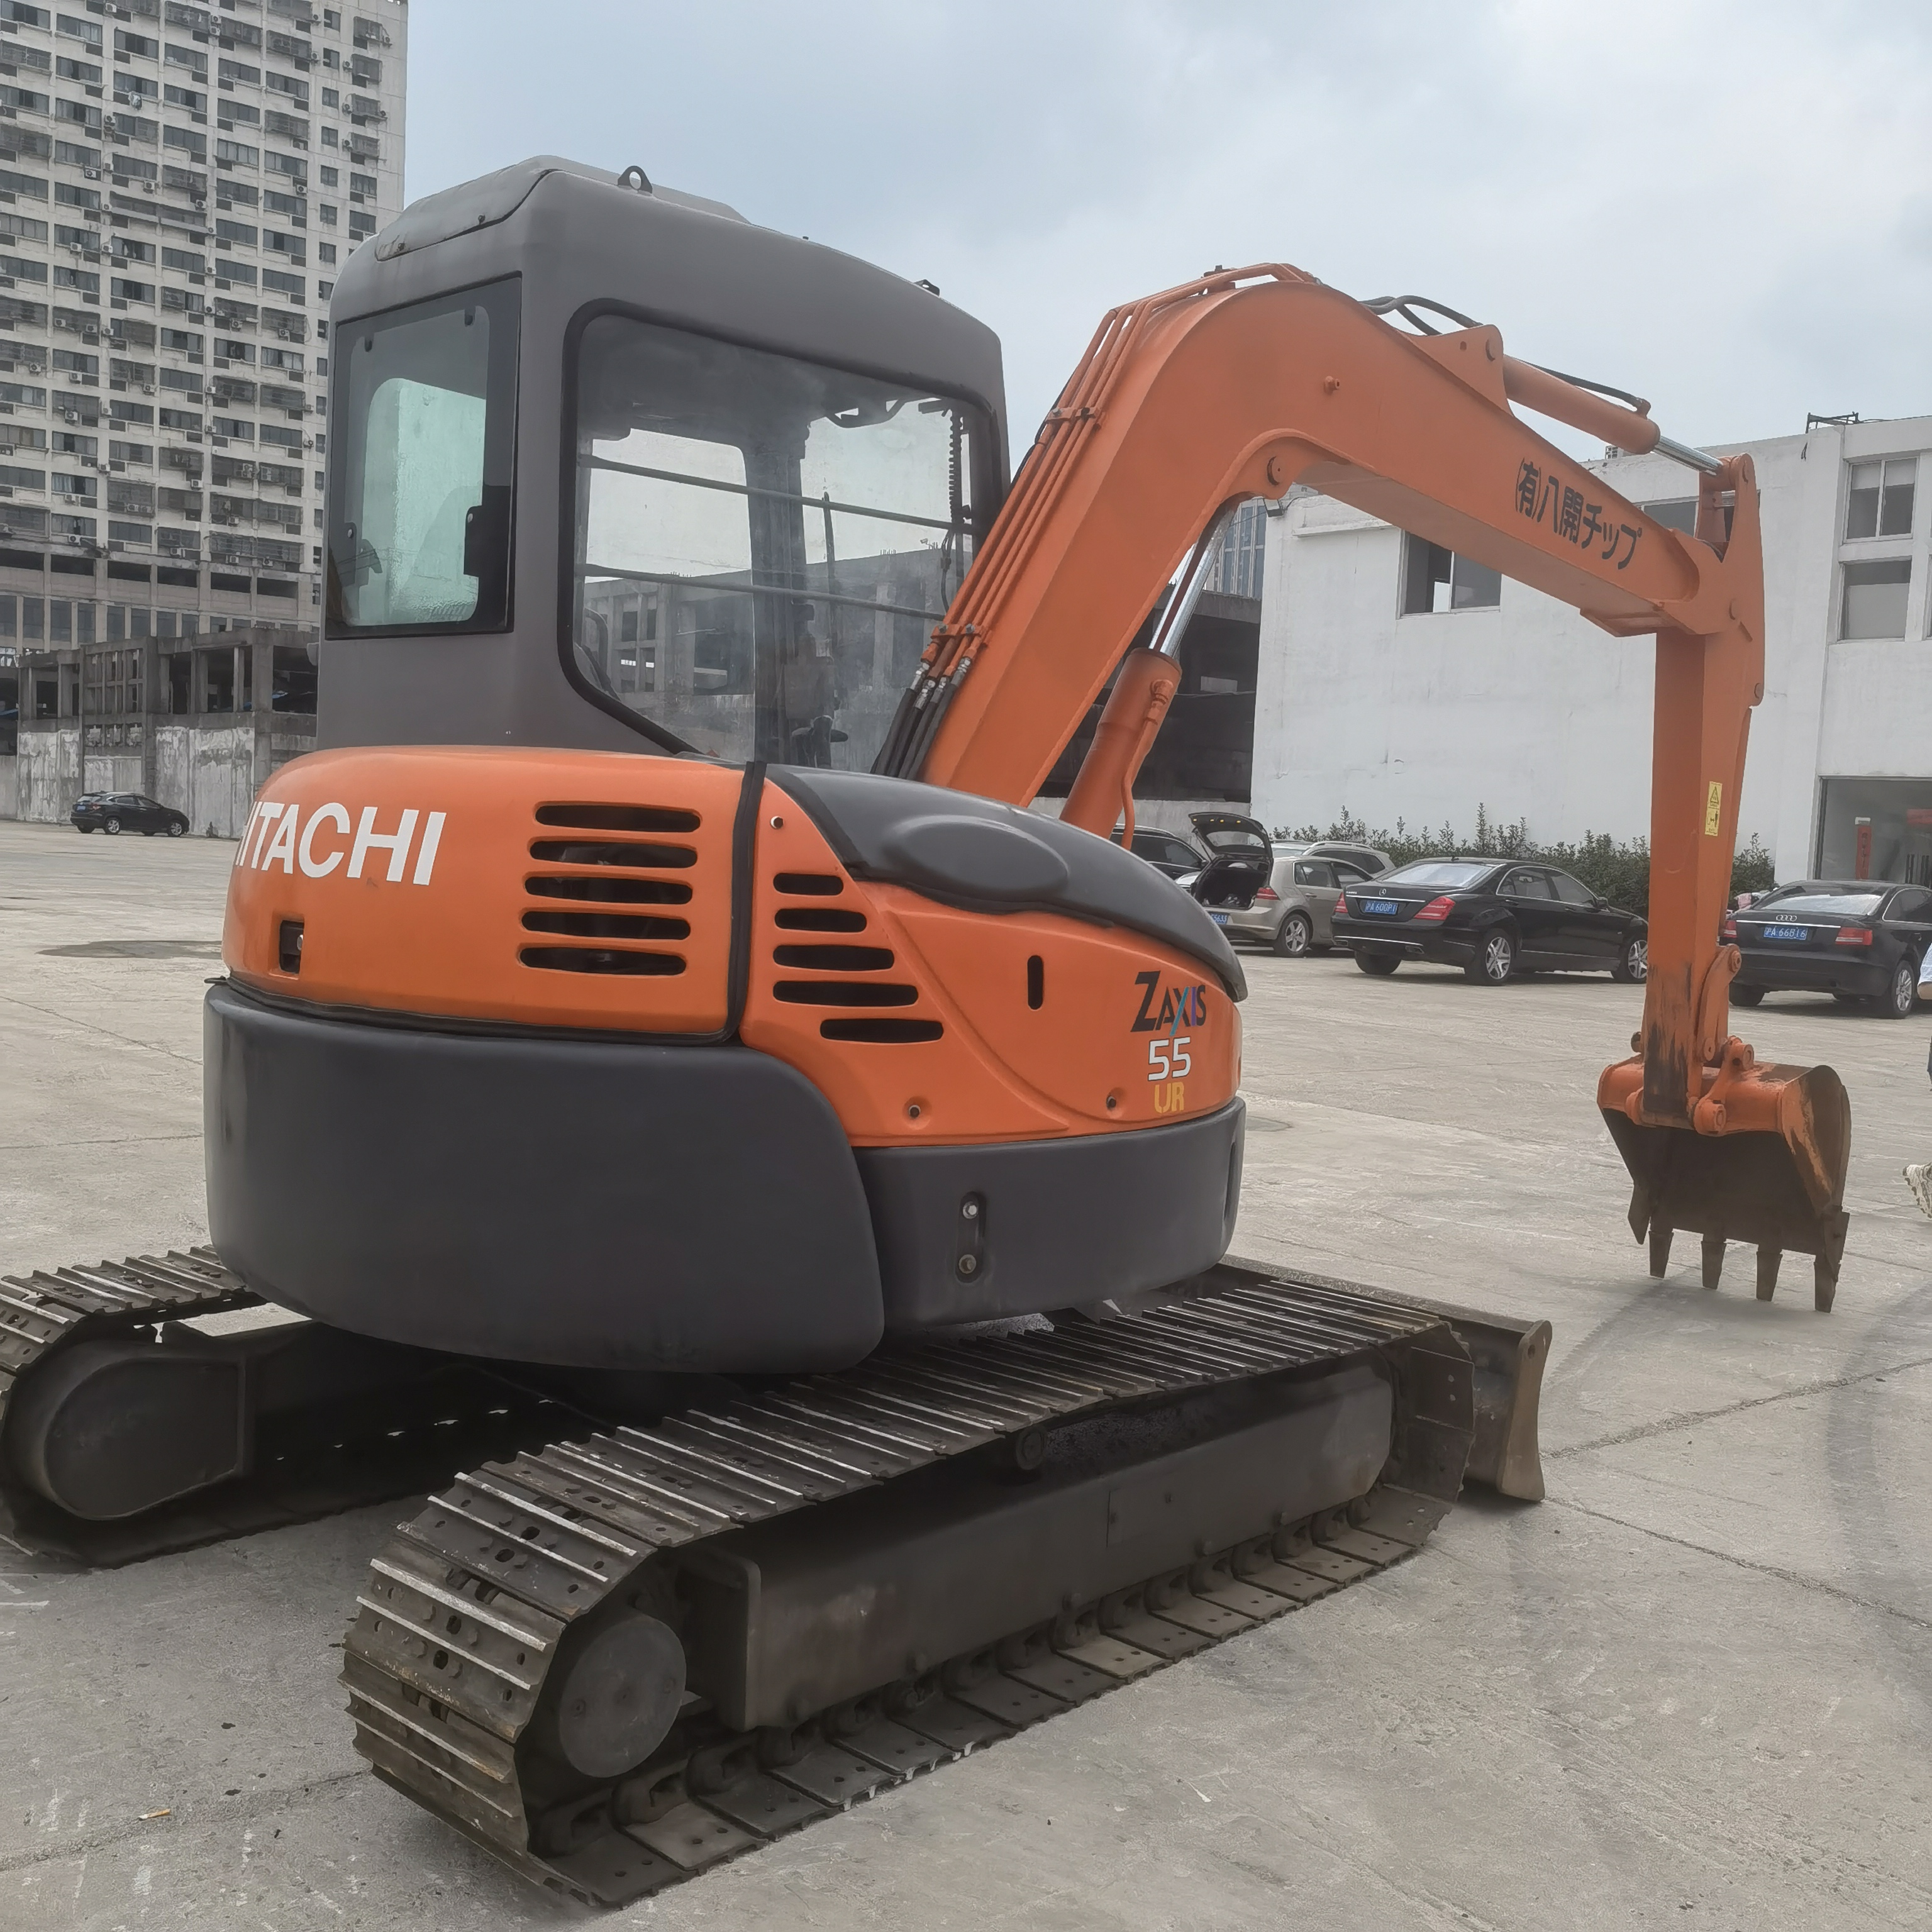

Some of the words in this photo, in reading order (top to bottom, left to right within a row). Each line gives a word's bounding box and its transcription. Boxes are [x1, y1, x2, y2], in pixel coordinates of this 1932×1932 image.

[235, 801, 447, 886] ITACHI
[1131, 970, 1207, 1036] ZAXIS
[1148, 1036, 1191, 1081] 55
[1154, 1082, 1185, 1113] UR
